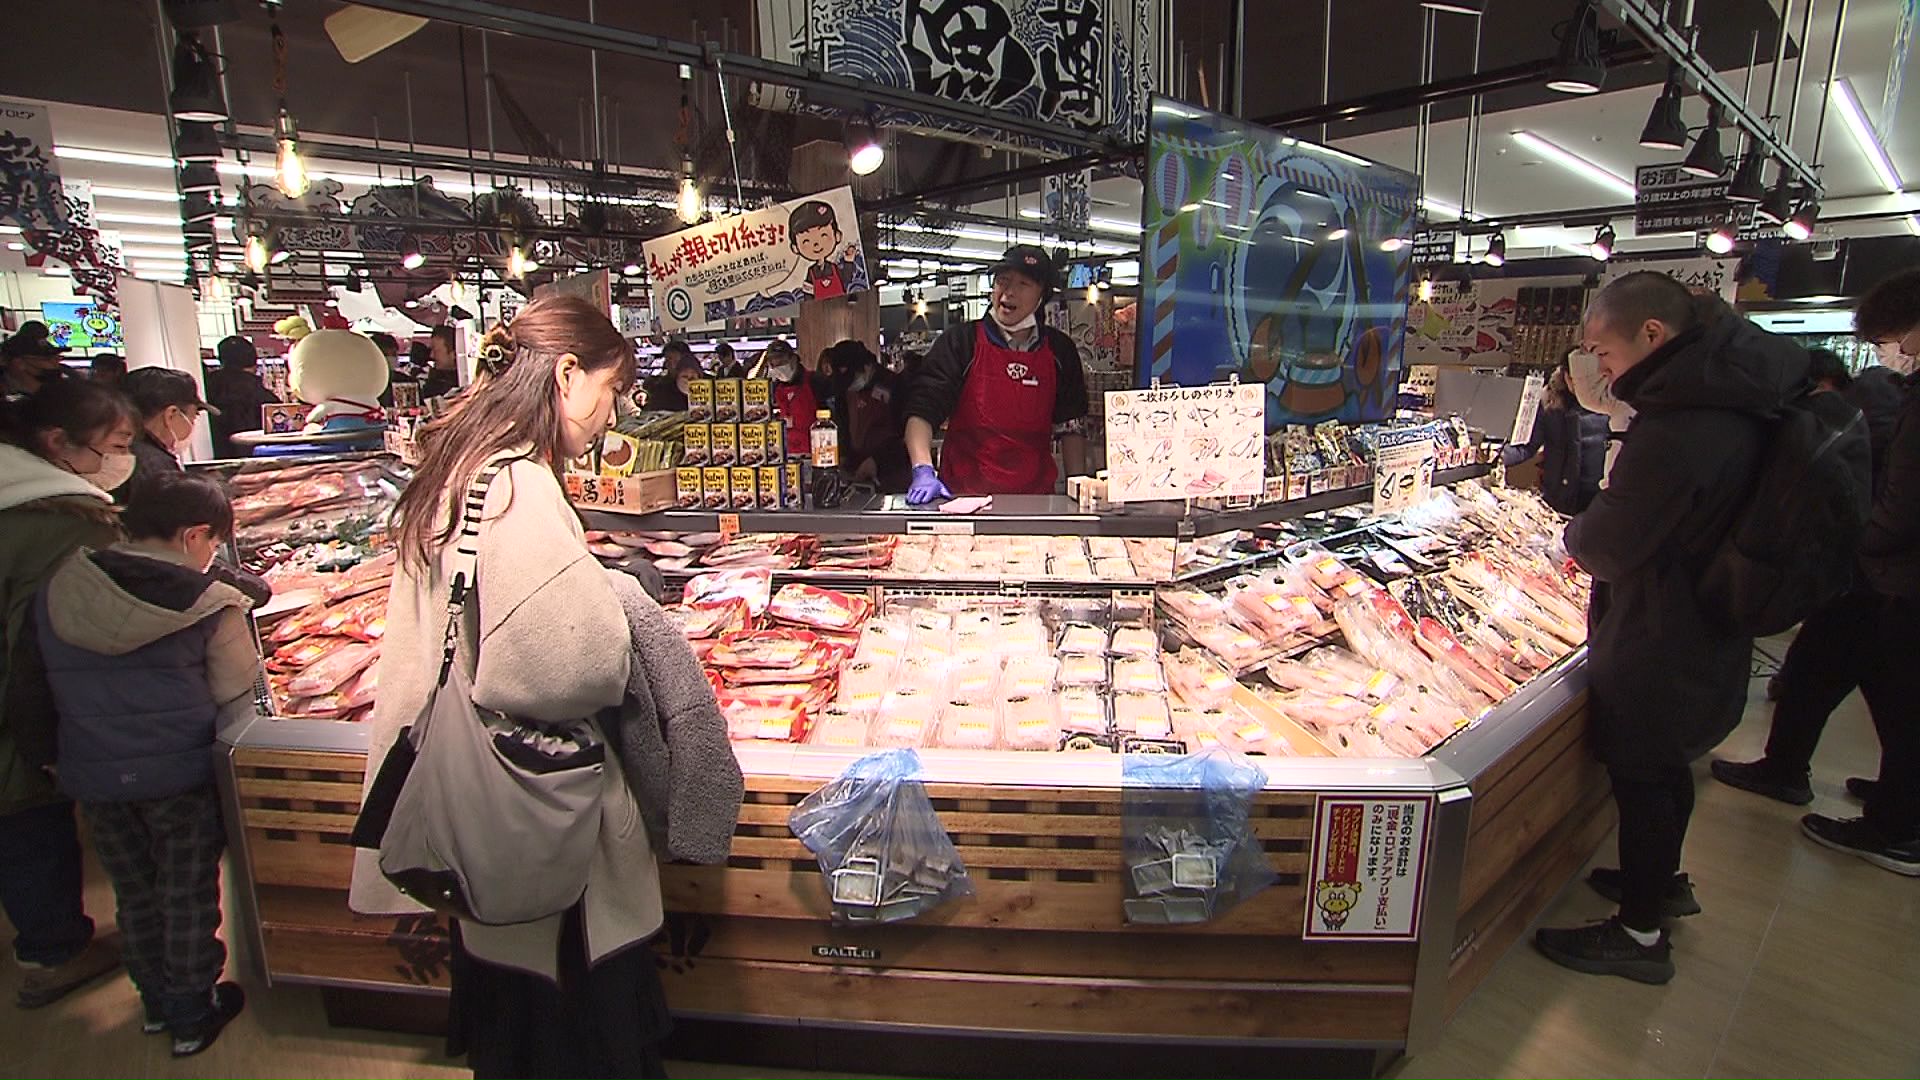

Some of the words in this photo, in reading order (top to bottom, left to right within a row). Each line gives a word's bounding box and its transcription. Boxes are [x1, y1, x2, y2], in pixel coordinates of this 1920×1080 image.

[1367, 804, 1385, 882] のみになります。
[1374, 805, 1400, 930] 「現金・ロピアアプリ支払い」
[1396, 804, 1415, 877] 当店のお会計は
[818, 946, 875, 959] GALILEI
